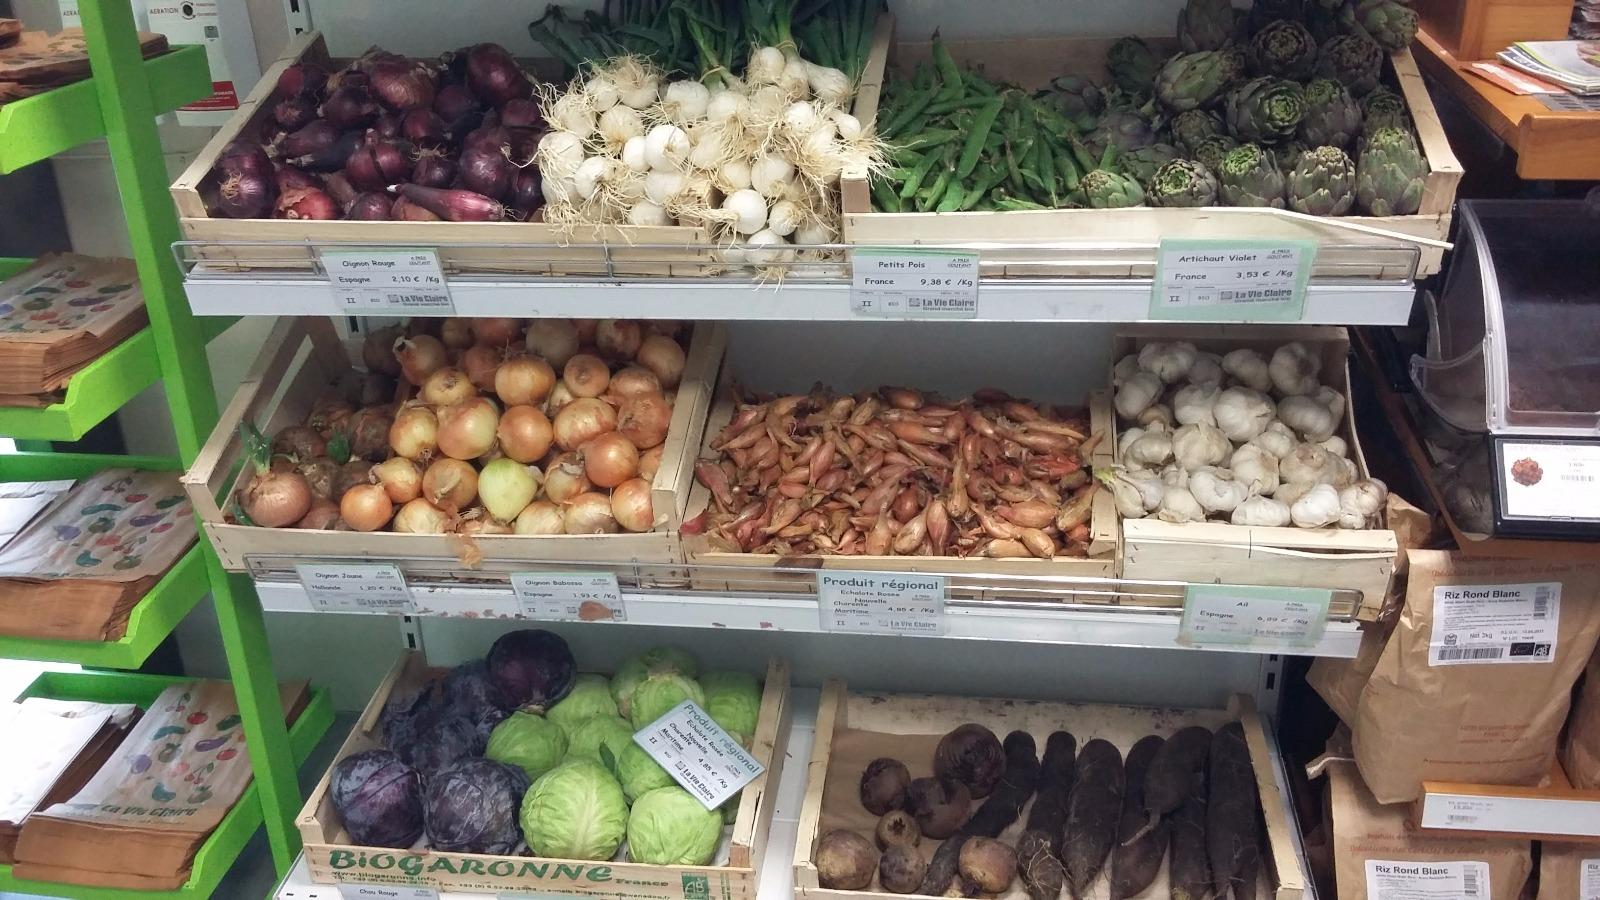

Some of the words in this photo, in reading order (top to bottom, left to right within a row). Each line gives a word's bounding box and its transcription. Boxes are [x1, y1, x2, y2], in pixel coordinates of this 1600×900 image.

[1178, 255, 1224, 263] Artichaut
[1229, 254, 1257, 262] Violet
[342, 260, 370, 268] Oignon
[372, 260, 396, 268] Rouge
[1276, 270, 1293, 278] /Kg
[957, 279, 973, 287] /Kg
[1248, 290, 1262, 298] Vie
[1264, 289, 1292, 297] Claire
[949, 299, 974, 307] Claire
[824, 577, 875, 588] Produit
[882, 579, 938, 591] régional
[1445, 591, 1460, 599] Riz
[1462, 590, 1489, 598] Rond
[1200, 610, 1234, 619] Espagne
[669, 722, 692, 746] Charente
[686, 719, 708, 742] Echalote
[684, 704, 719, 736] Produit
[720, 737, 760, 774] régional
[686, 732, 708, 755] Nouvelle
[660, 728, 684, 751] Maritime
[698, 758, 712, 772] 4,85
[718, 778, 728, 789] /Kg
[683, 768, 692, 777] La
[690, 773, 700, 785] Vie
[698, 780, 715, 800] Claire
[122, 806, 148, 815] Vie
[149, 808, 197, 817] Claire
[1393, 866, 1419, 874] Rond
[616, 878, 669, 886] France
